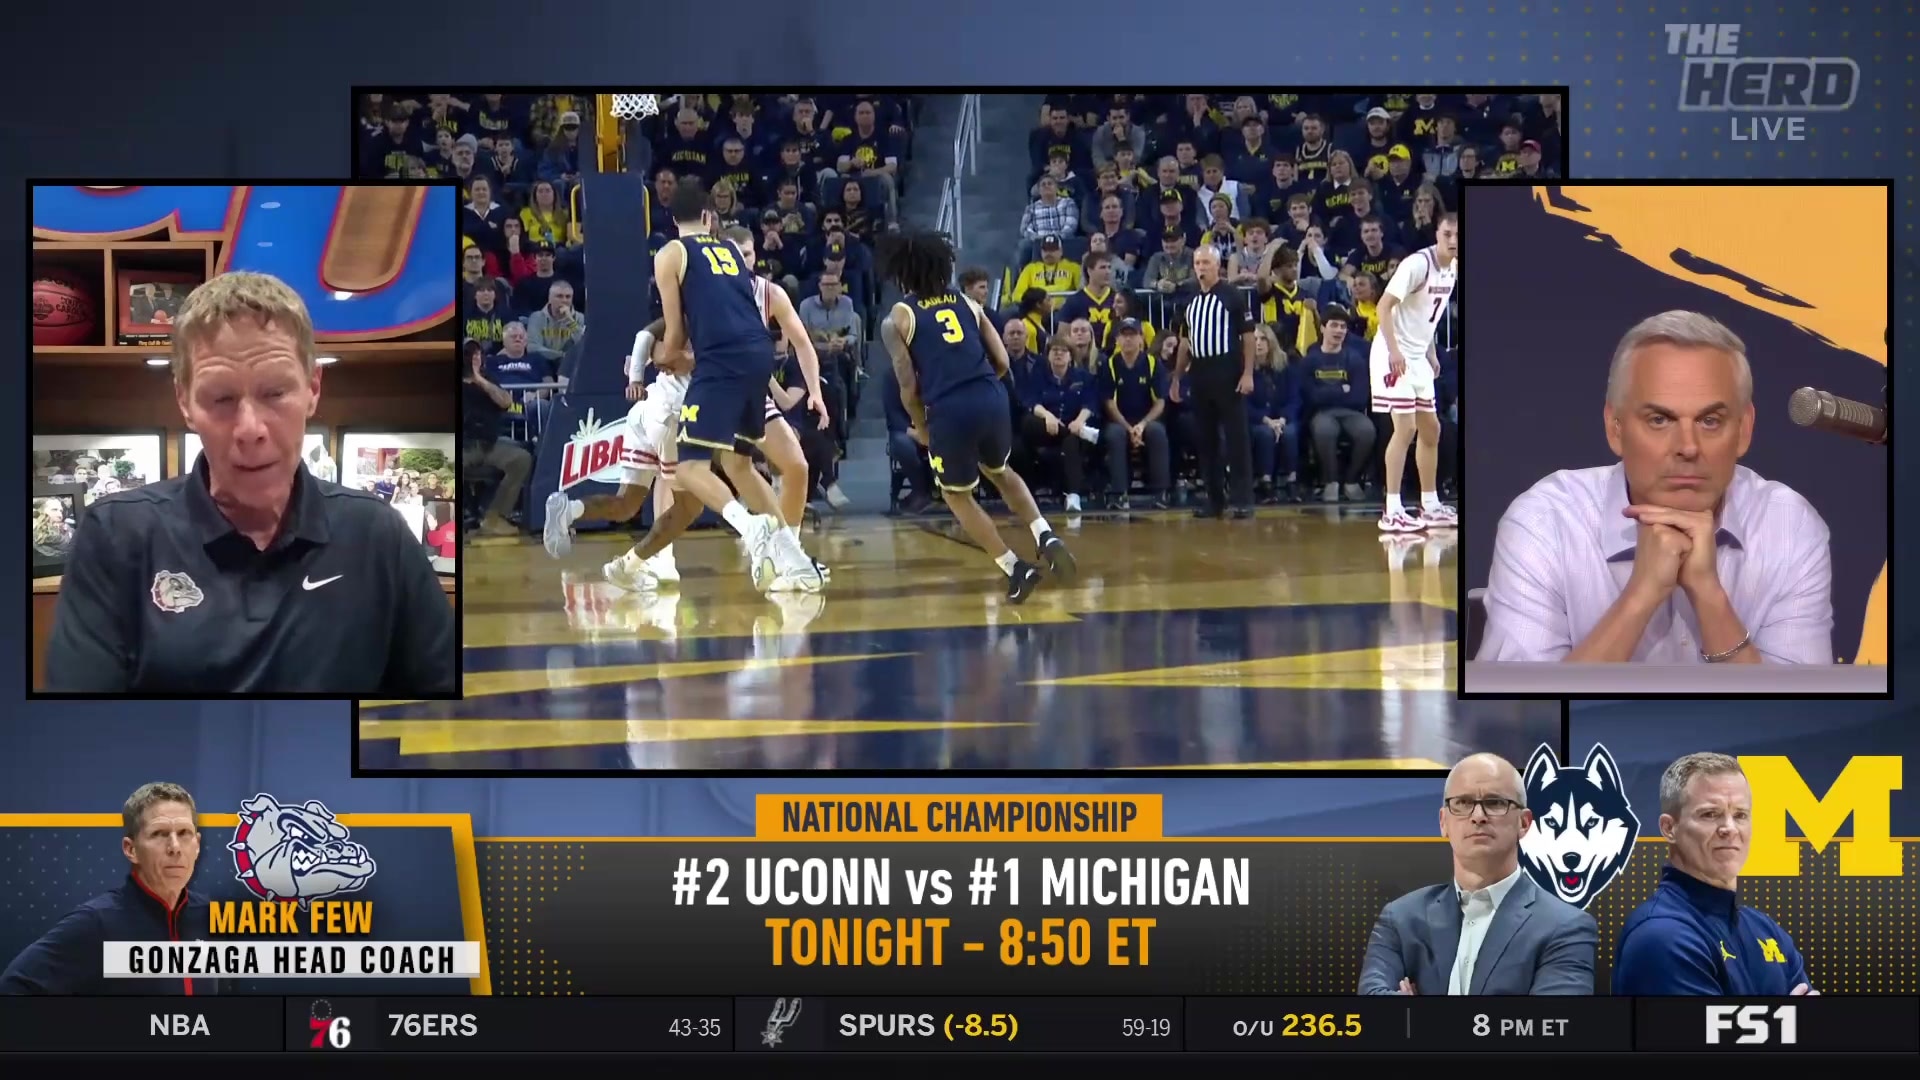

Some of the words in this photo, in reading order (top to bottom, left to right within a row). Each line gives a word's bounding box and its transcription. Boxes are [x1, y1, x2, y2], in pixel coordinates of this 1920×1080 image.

[701, 246, 740, 276] 15
[917, 295, 957, 309] CADEAU
[1429, 297, 1442, 323] 7
[935, 309, 964, 344] 3
[1088, 307, 1111, 324] M
[680, 404, 700, 422] M
